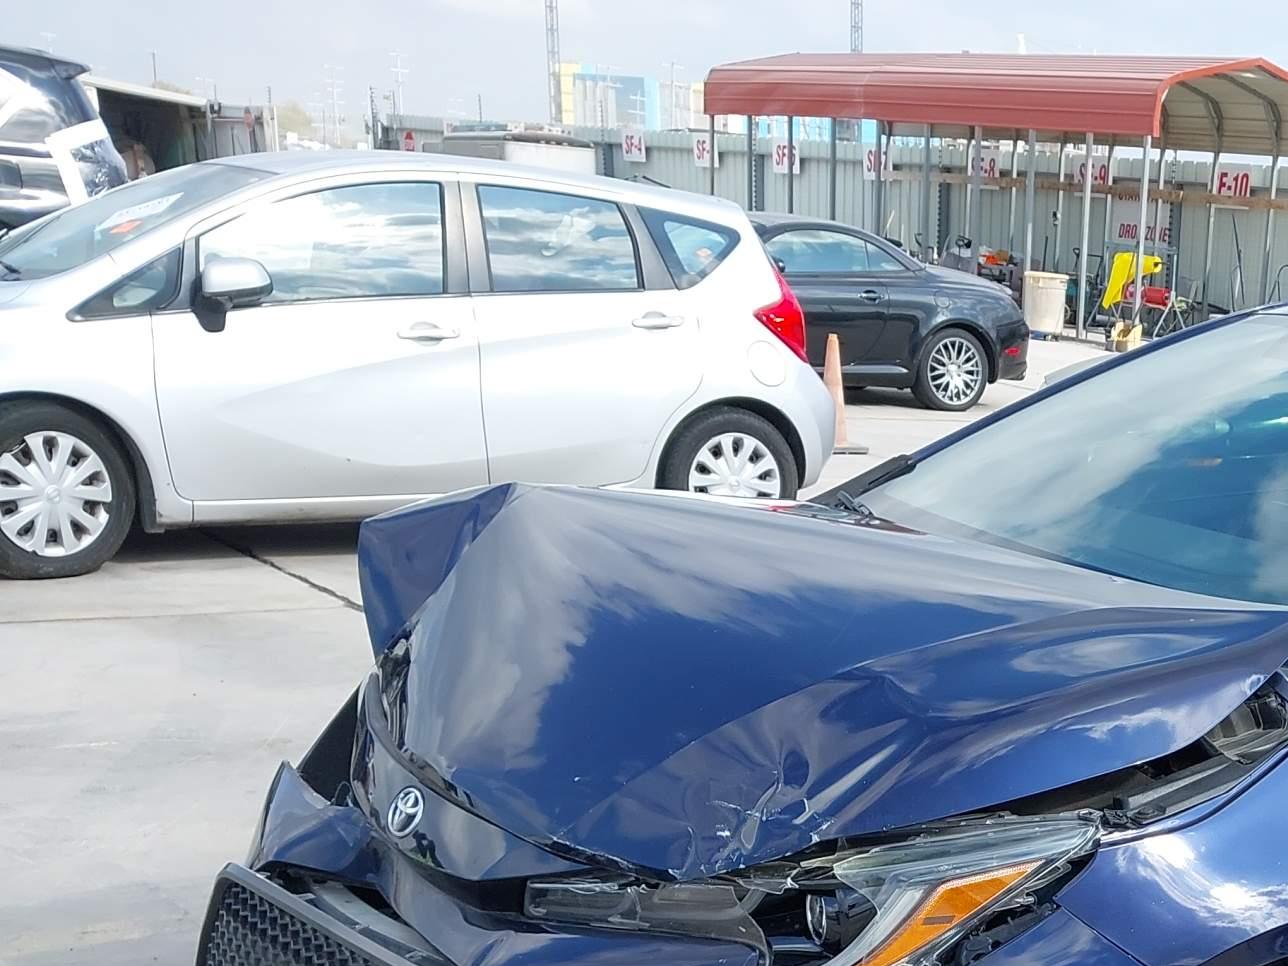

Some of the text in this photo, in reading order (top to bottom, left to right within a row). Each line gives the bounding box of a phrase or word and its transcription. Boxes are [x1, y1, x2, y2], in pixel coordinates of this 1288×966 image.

[624, 134, 643, 155] SF-4
[696, 138, 712, 161] SF-
[776, 144, 797, 166] SF6
[1119, 223, 1138, 240] DRO
